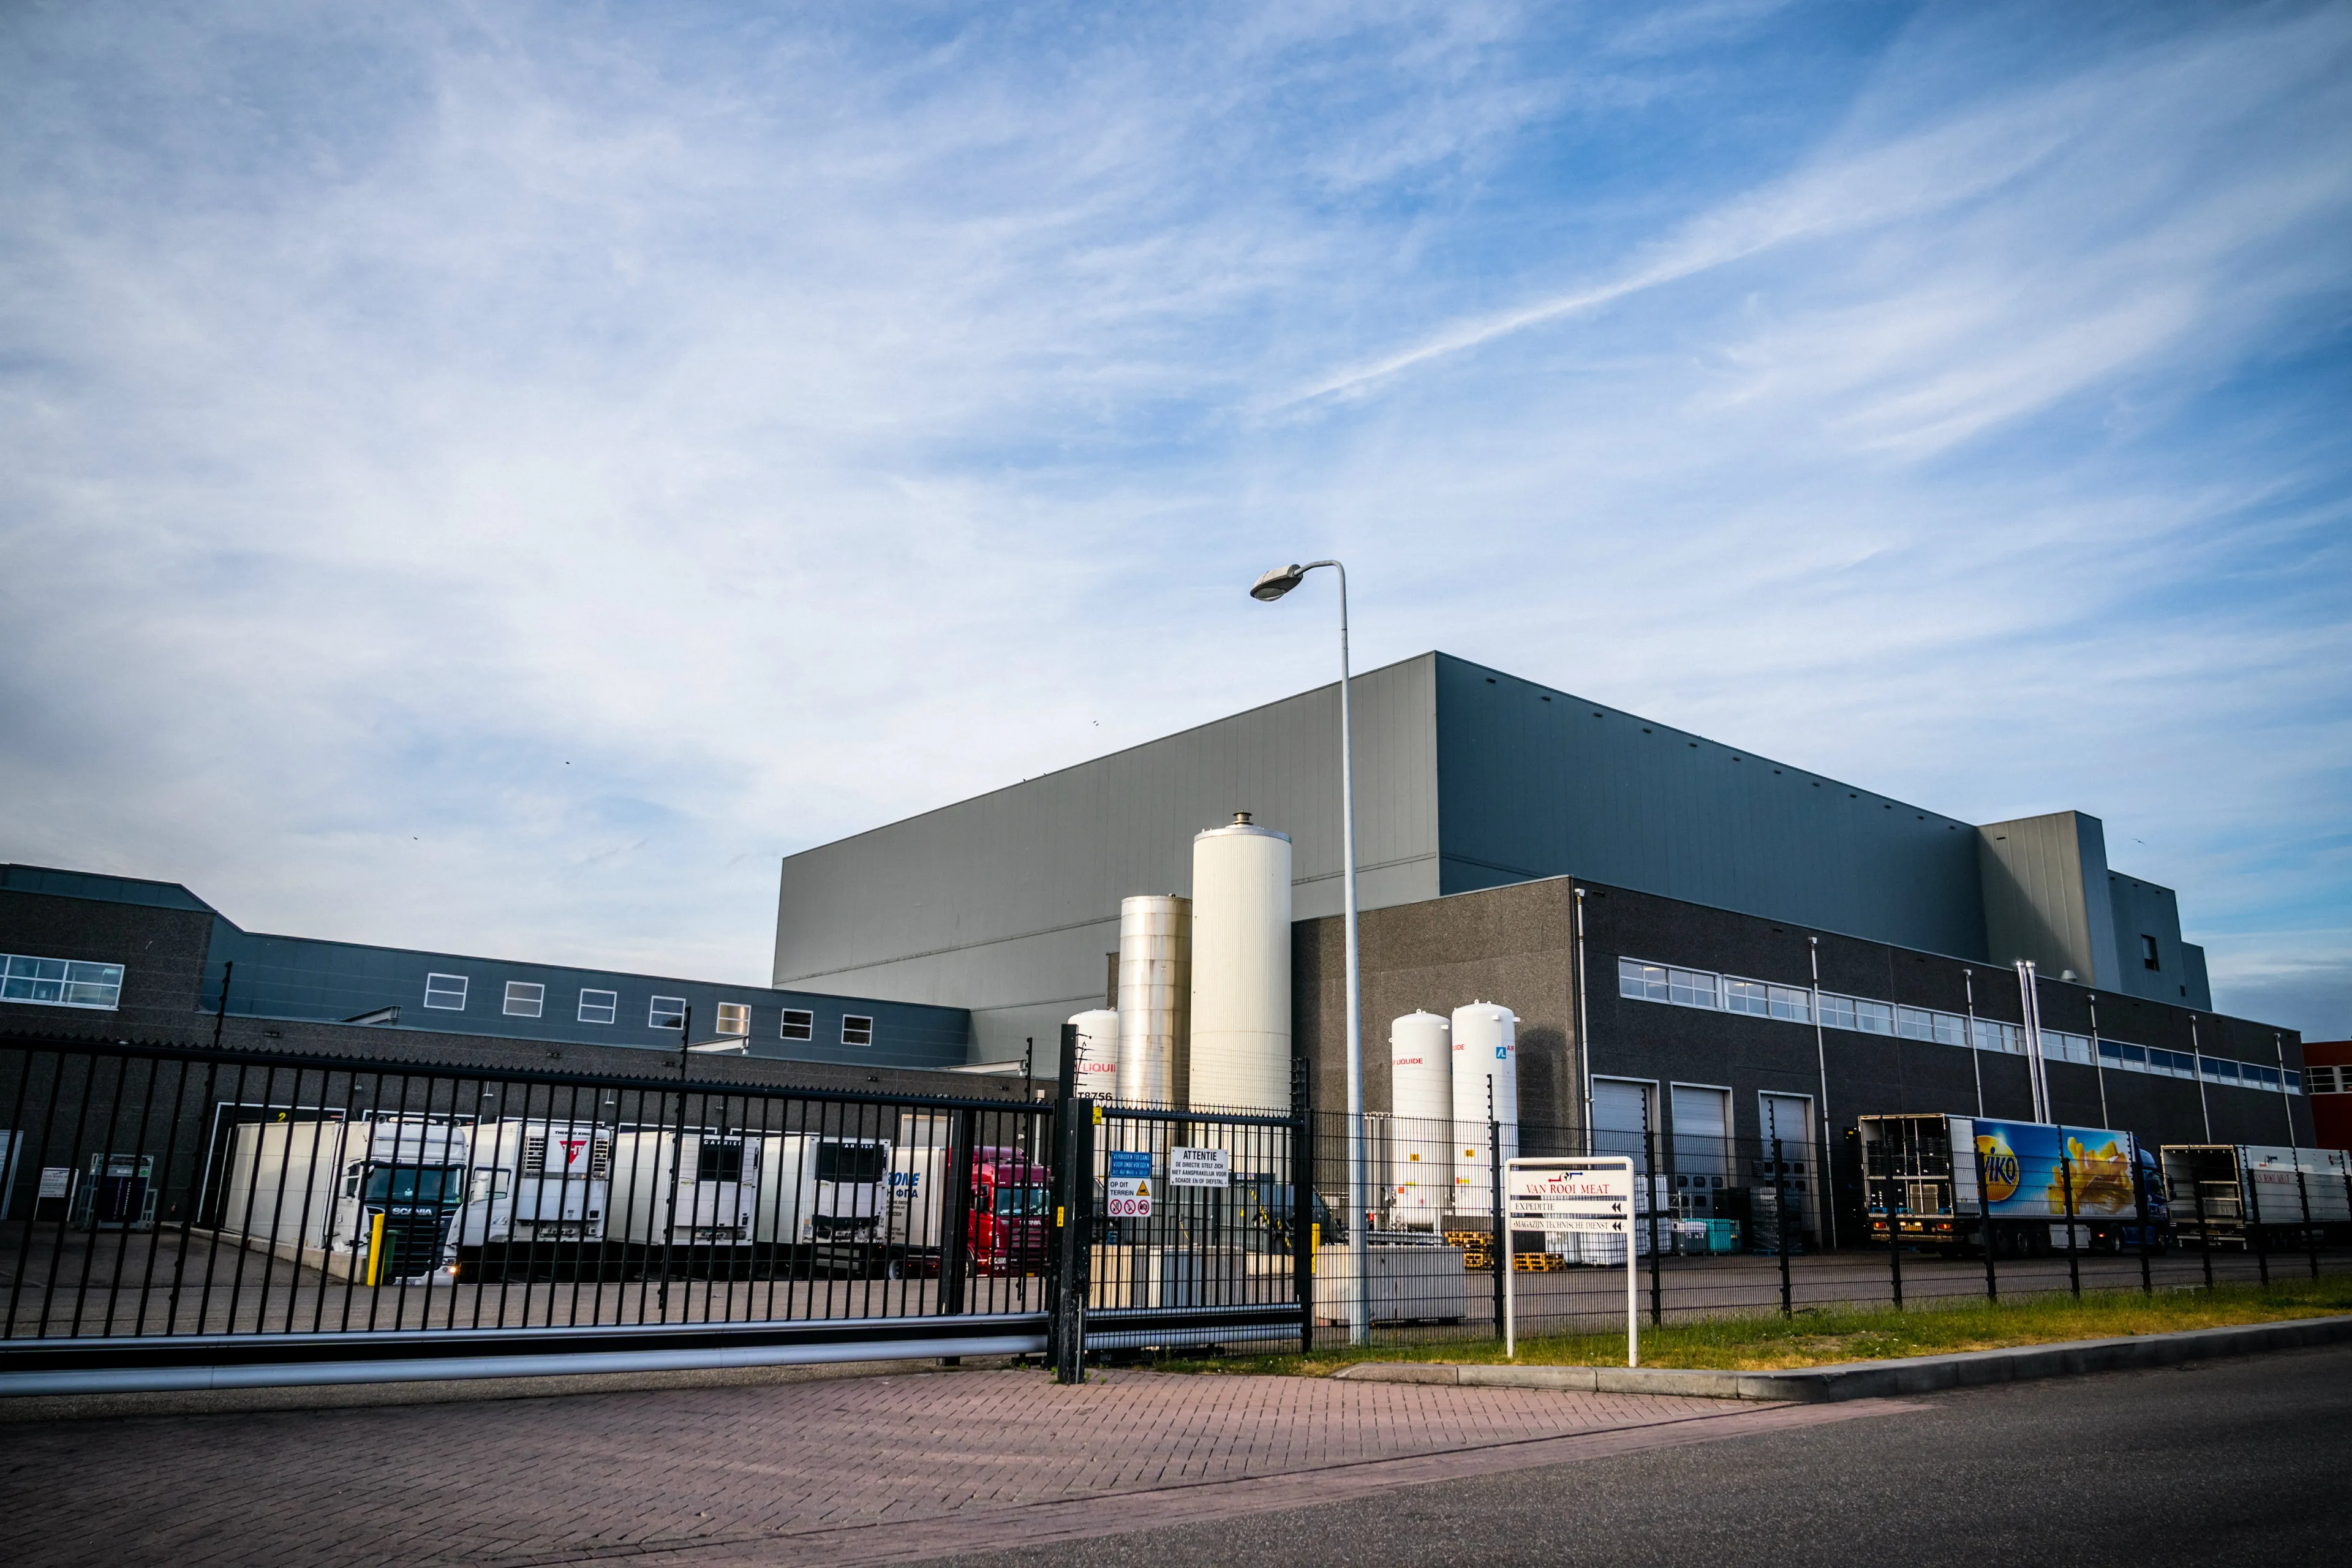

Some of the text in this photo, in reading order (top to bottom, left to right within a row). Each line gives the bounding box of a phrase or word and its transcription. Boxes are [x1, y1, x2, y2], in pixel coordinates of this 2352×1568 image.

[1083, 1063, 1116, 1072] LIQUI
[1183, 1150, 1217, 1161] ATTENTIE
[1526, 1184, 1610, 1194] VAN ROOI MEAT
[1515, 1220, 1609, 1230] MAGAZIJN TECHNISCHE DIENST
